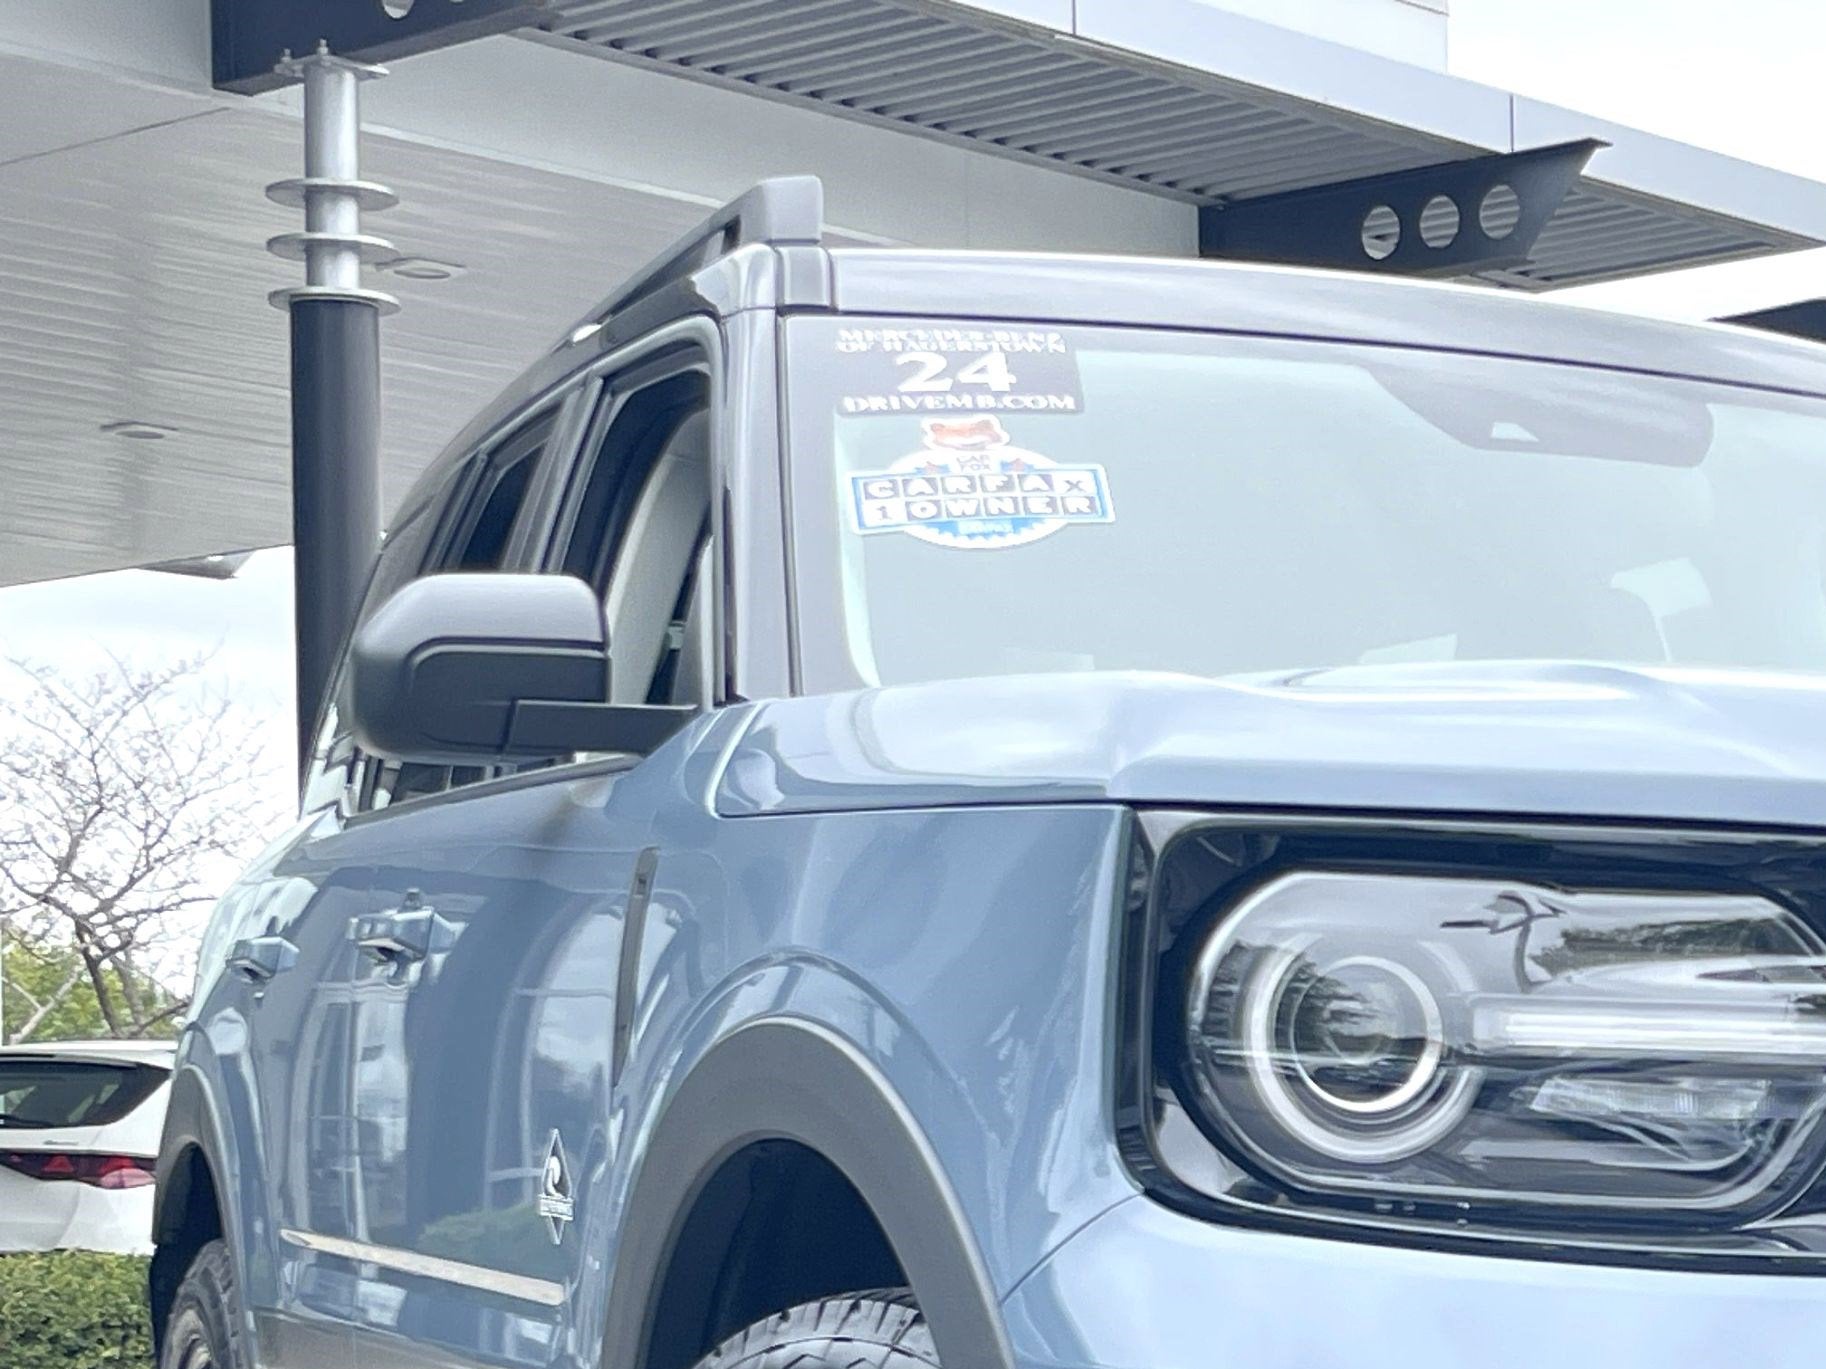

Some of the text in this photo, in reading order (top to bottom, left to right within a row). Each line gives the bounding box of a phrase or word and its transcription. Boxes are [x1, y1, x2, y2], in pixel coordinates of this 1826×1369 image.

[895, 350, 1017, 393] 24
[842, 394, 1076, 413] DRIVEMB.COM
[866, 474, 1085, 498] CARFAX
[876, 496, 1092, 521] 1 OWNER
